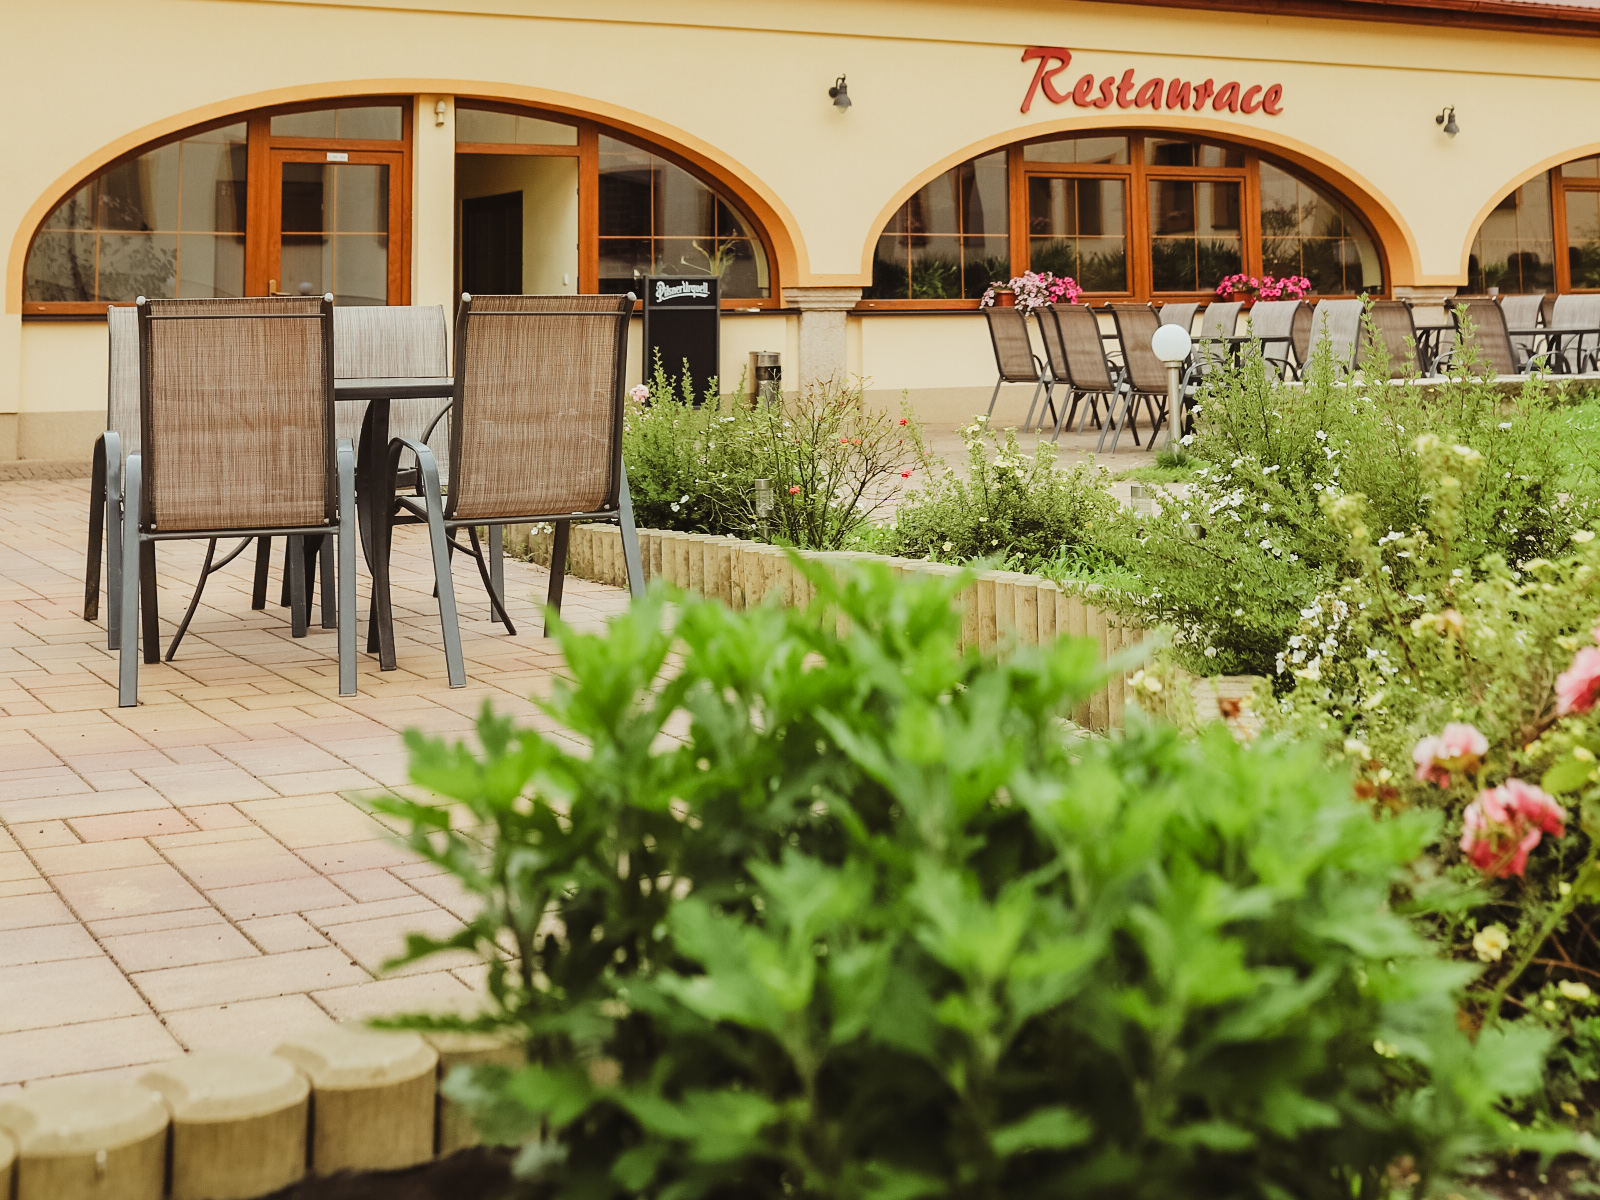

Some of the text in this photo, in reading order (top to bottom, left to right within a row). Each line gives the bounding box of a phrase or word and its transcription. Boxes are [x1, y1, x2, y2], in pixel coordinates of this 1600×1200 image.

[1020, 46, 1284, 116] Restaurace
[655, 280, 708, 303] Pilsner Urquell
